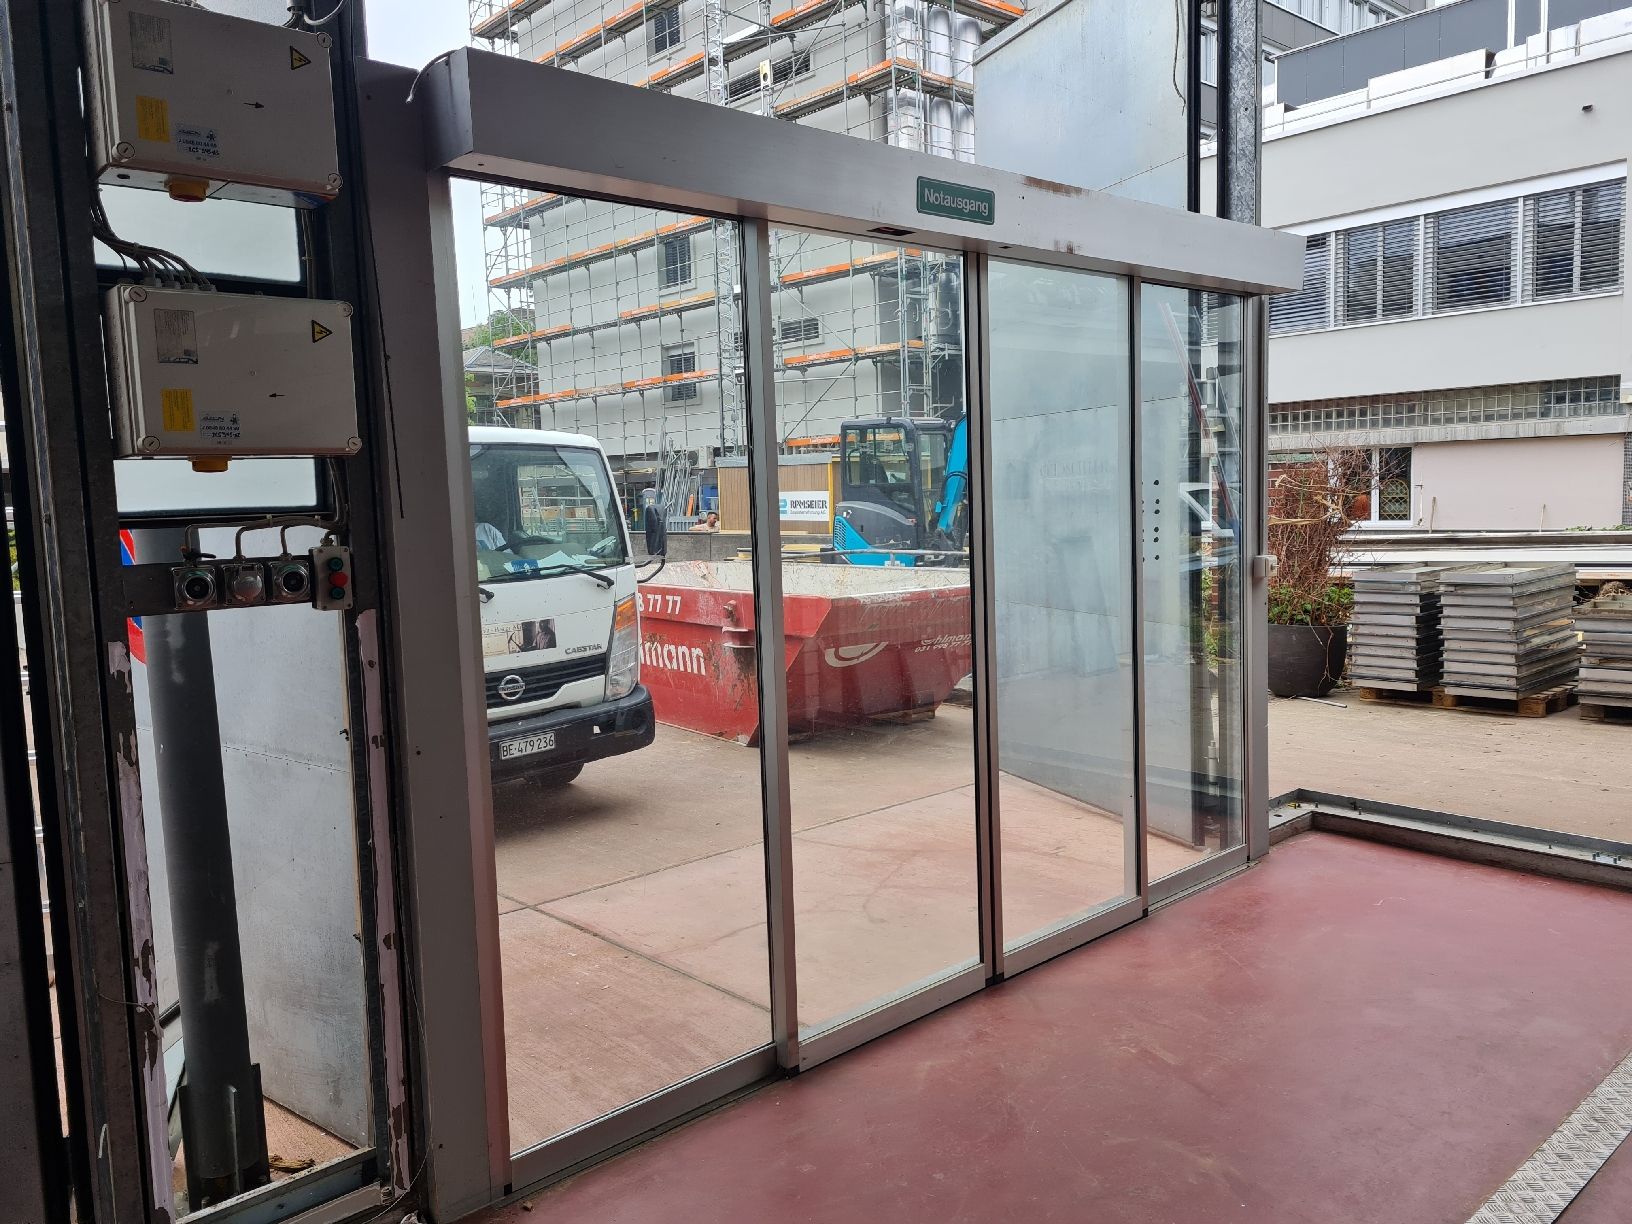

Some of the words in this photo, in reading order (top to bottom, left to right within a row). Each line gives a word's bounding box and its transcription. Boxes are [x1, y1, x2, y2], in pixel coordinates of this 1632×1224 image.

[924, 187, 989, 217] Notausgang
[647, 593, 662, 613] 77
[665, 595, 682, 615] 77
[564, 643, 603, 655] CABSTAR
